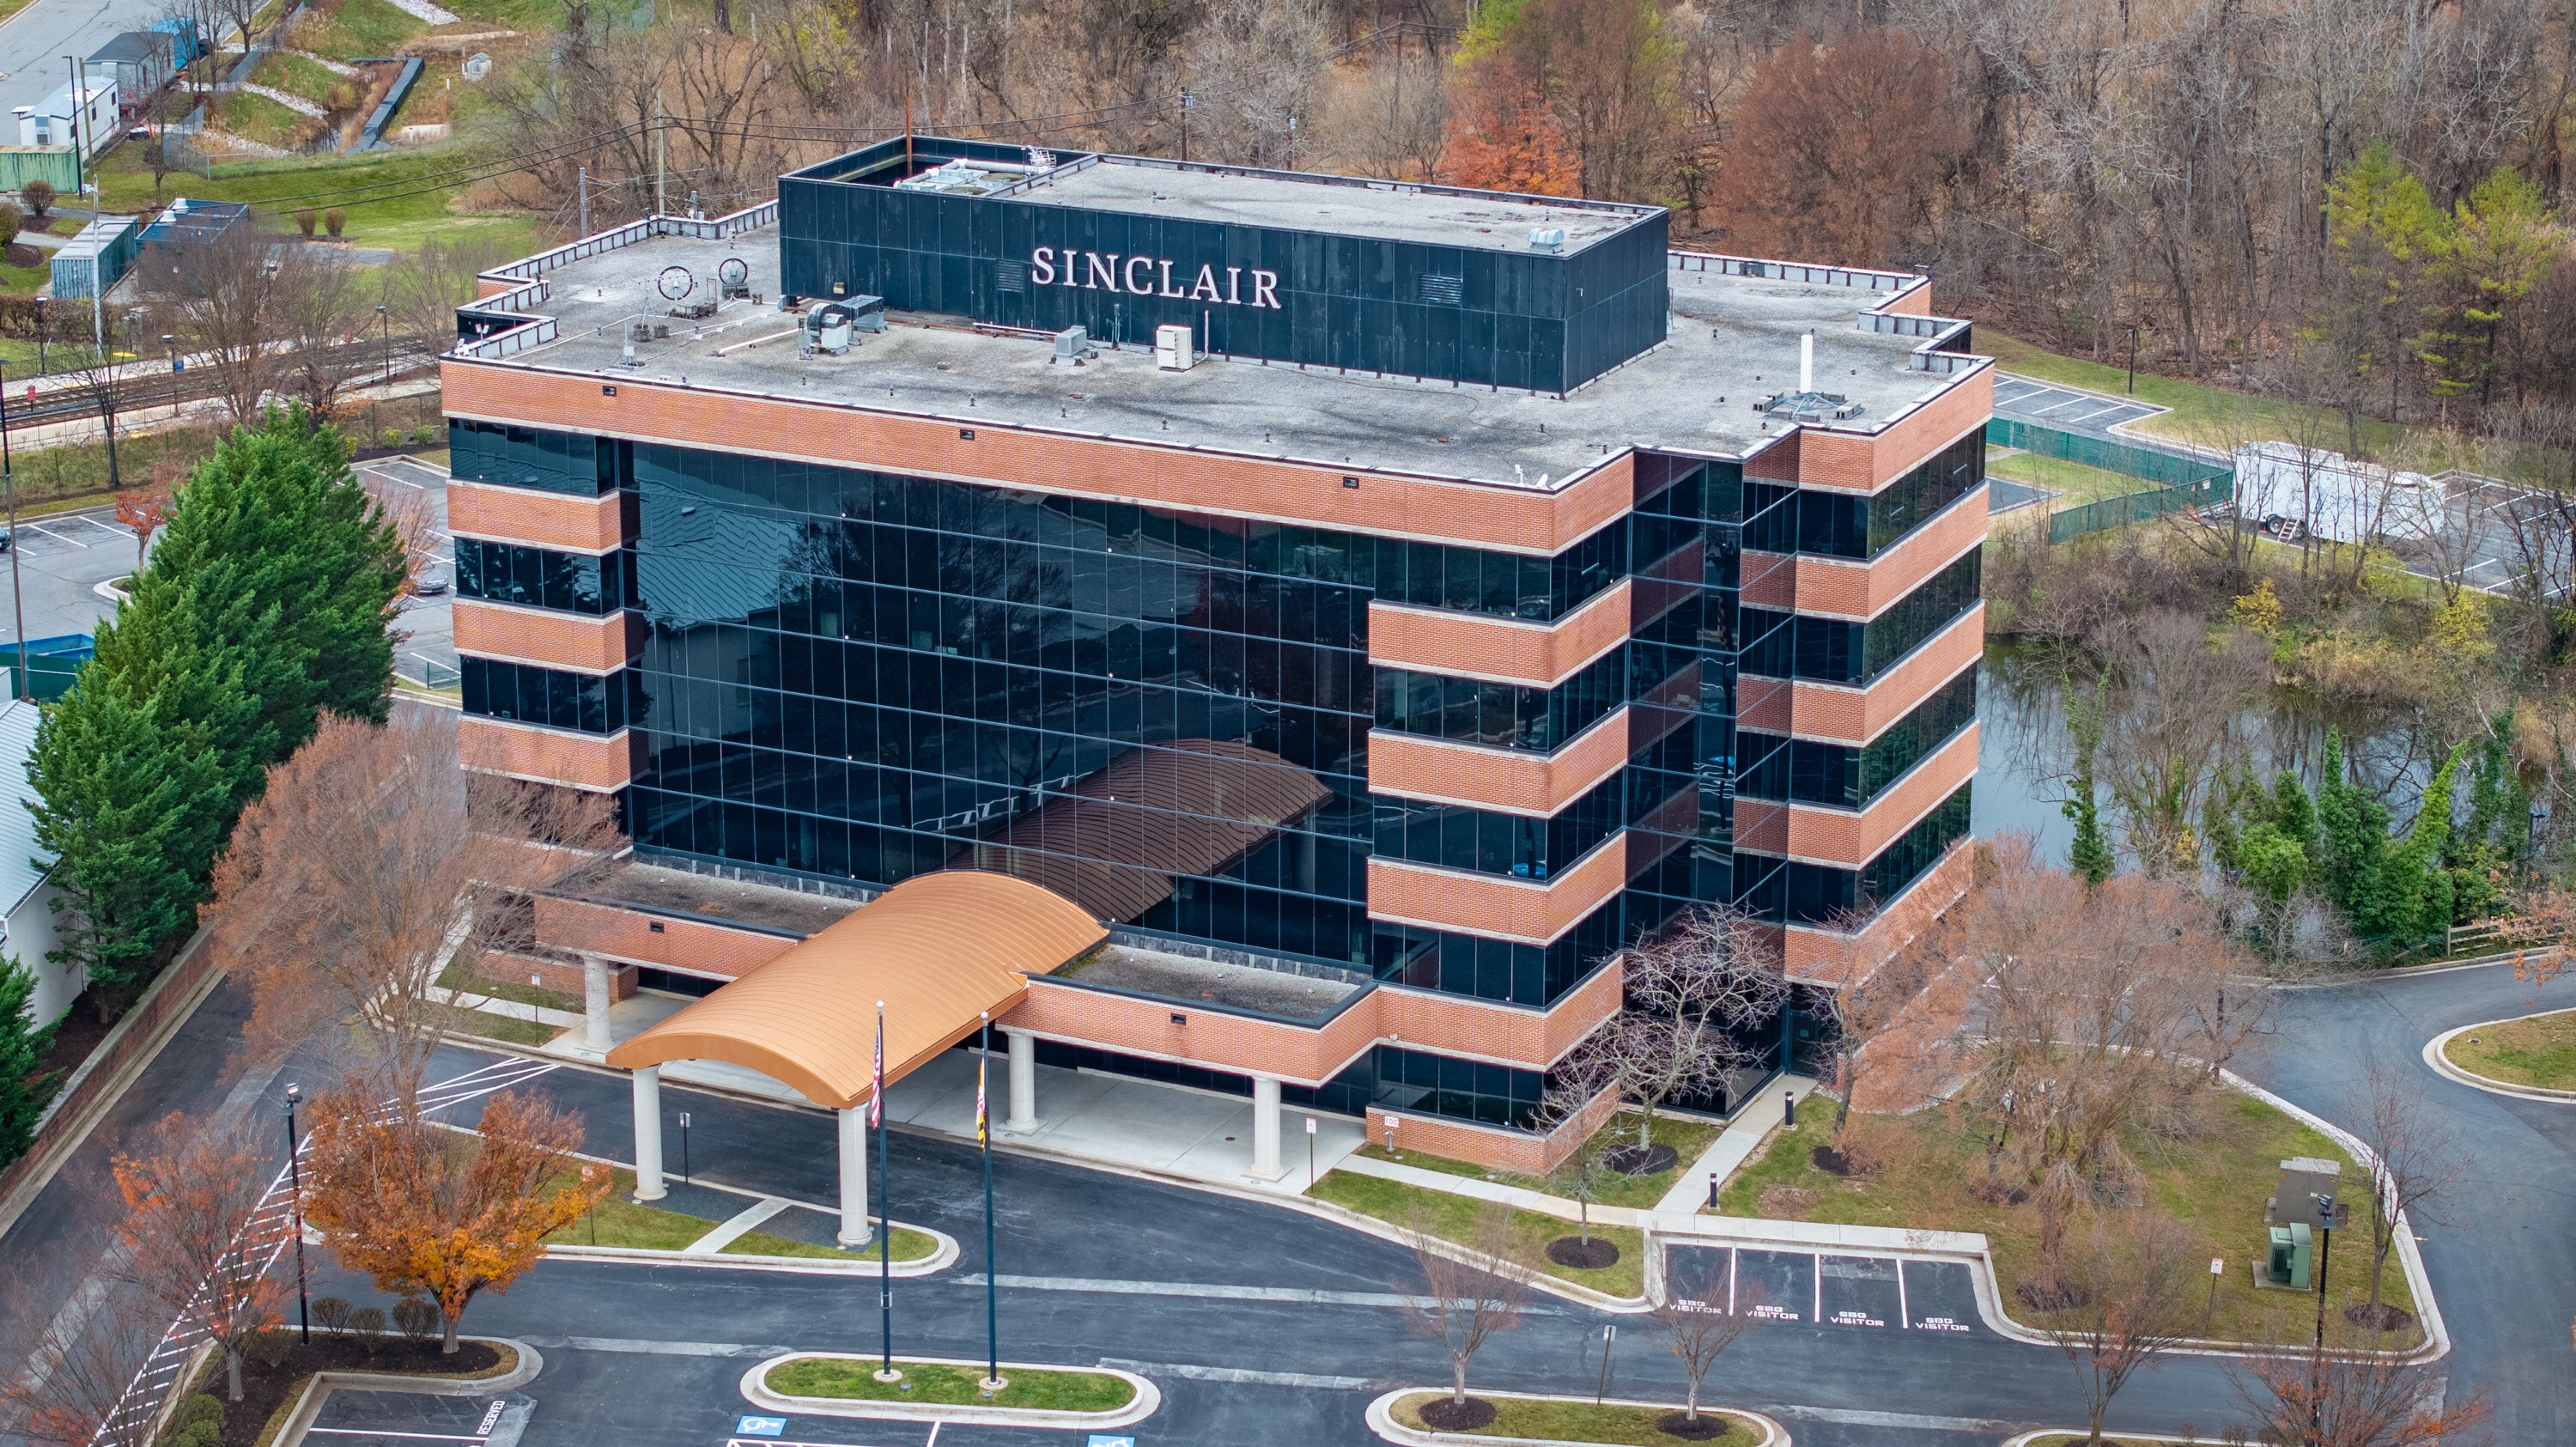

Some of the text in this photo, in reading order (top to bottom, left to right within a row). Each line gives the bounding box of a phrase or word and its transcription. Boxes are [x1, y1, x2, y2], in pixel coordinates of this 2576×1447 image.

[1032, 246, 1281, 309] SINCLAIR
[1669, 1304, 1722, 1315] VISITOR
[1746, 1310, 1799, 1320] VISITOR
[1830, 1316, 1884, 1327] VISITOR
[1915, 1322, 1970, 1331] VISITOR
[477, 1401, 505, 1434] RESERVED
